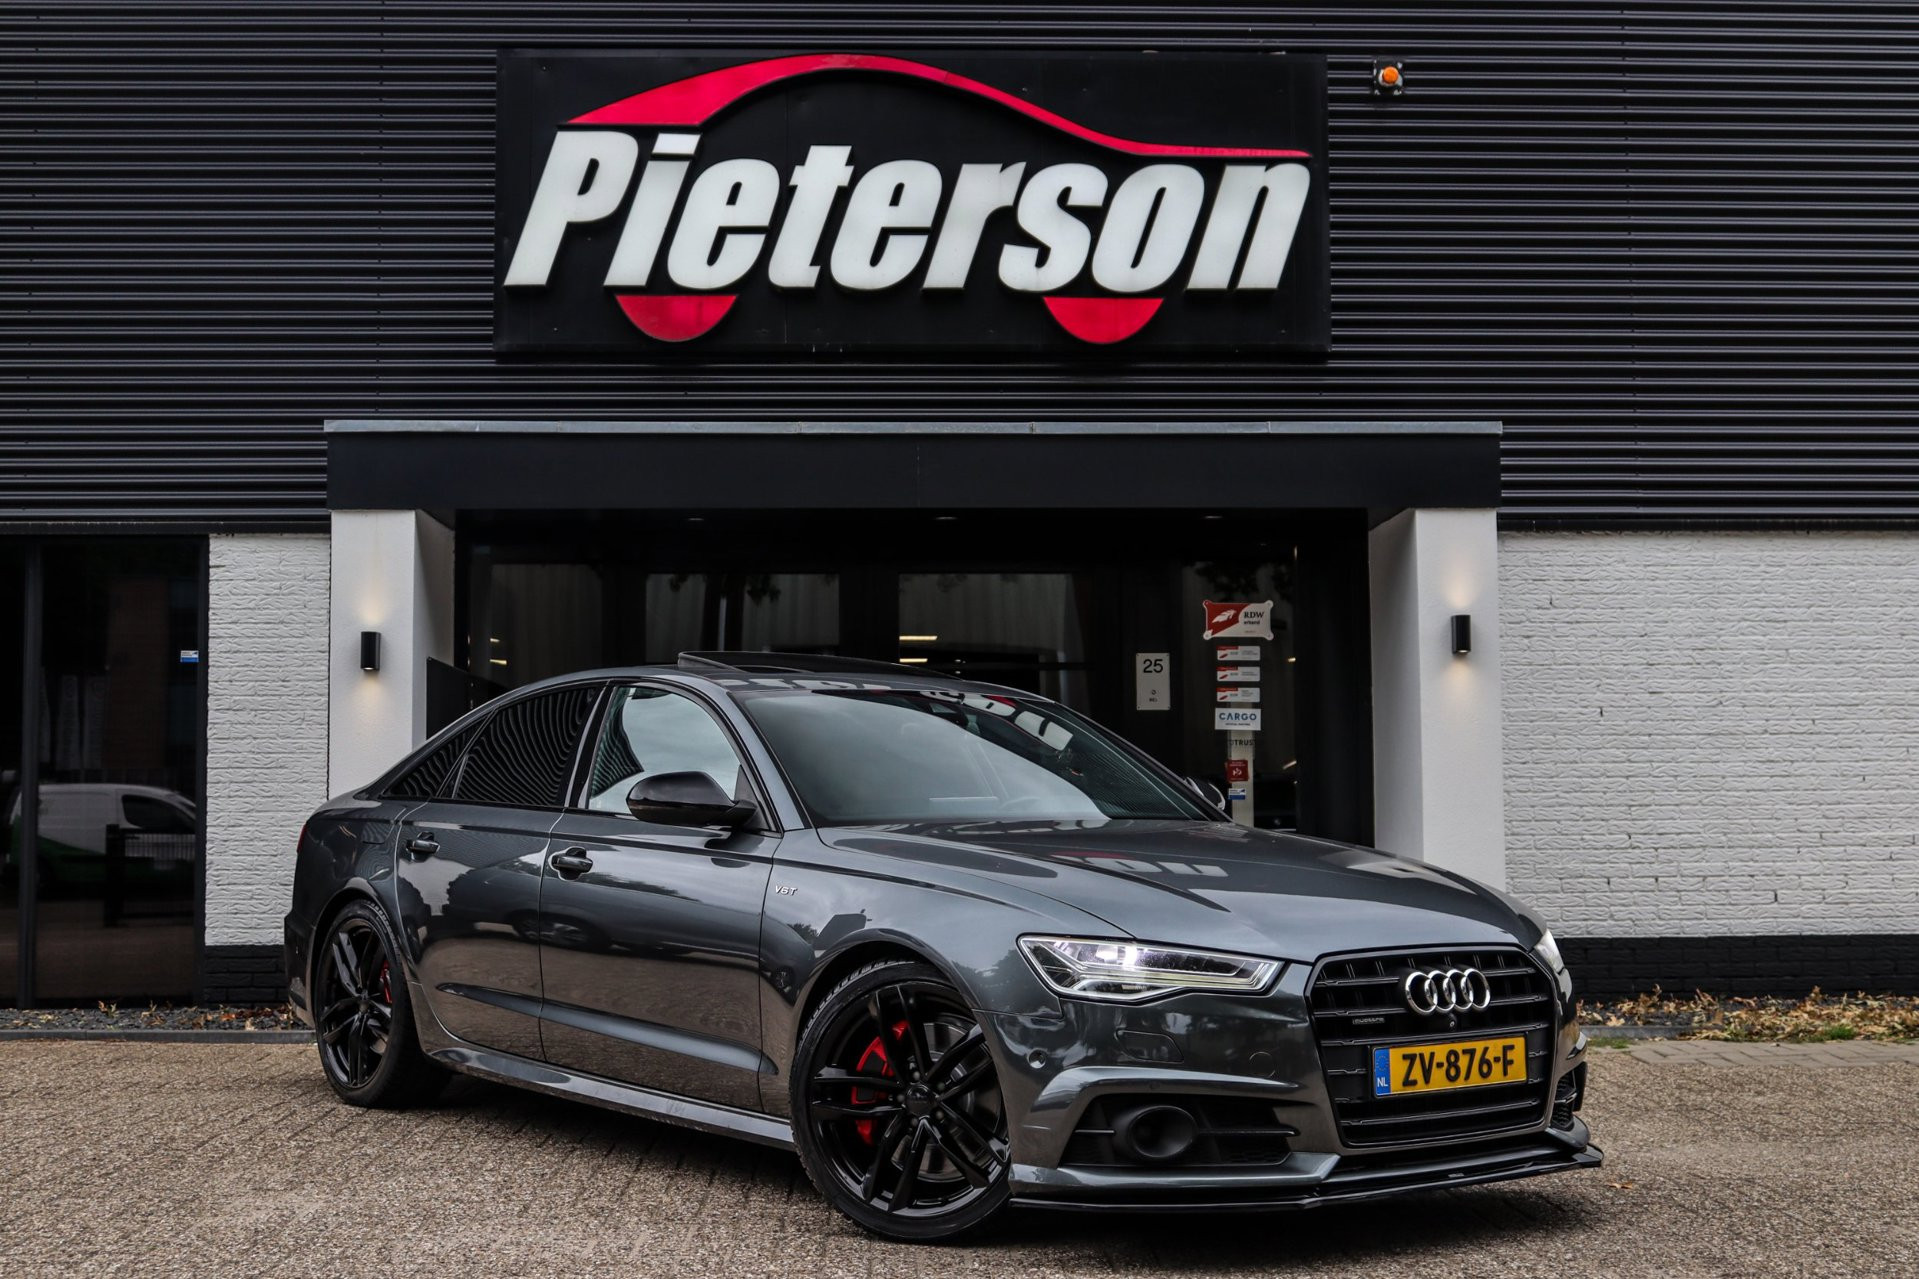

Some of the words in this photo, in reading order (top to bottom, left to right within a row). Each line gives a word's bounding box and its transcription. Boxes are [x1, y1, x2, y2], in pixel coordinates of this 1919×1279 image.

[504, 130, 1310, 291] Pieterson
[1143, 658, 1164, 673] 25
[1219, 713, 1257, 721] CARGO
[775, 884, 799, 896] V6T
[1402, 1045, 1515, 1086] ZV-876-F
[1376, 1077, 1388, 1088] NL
